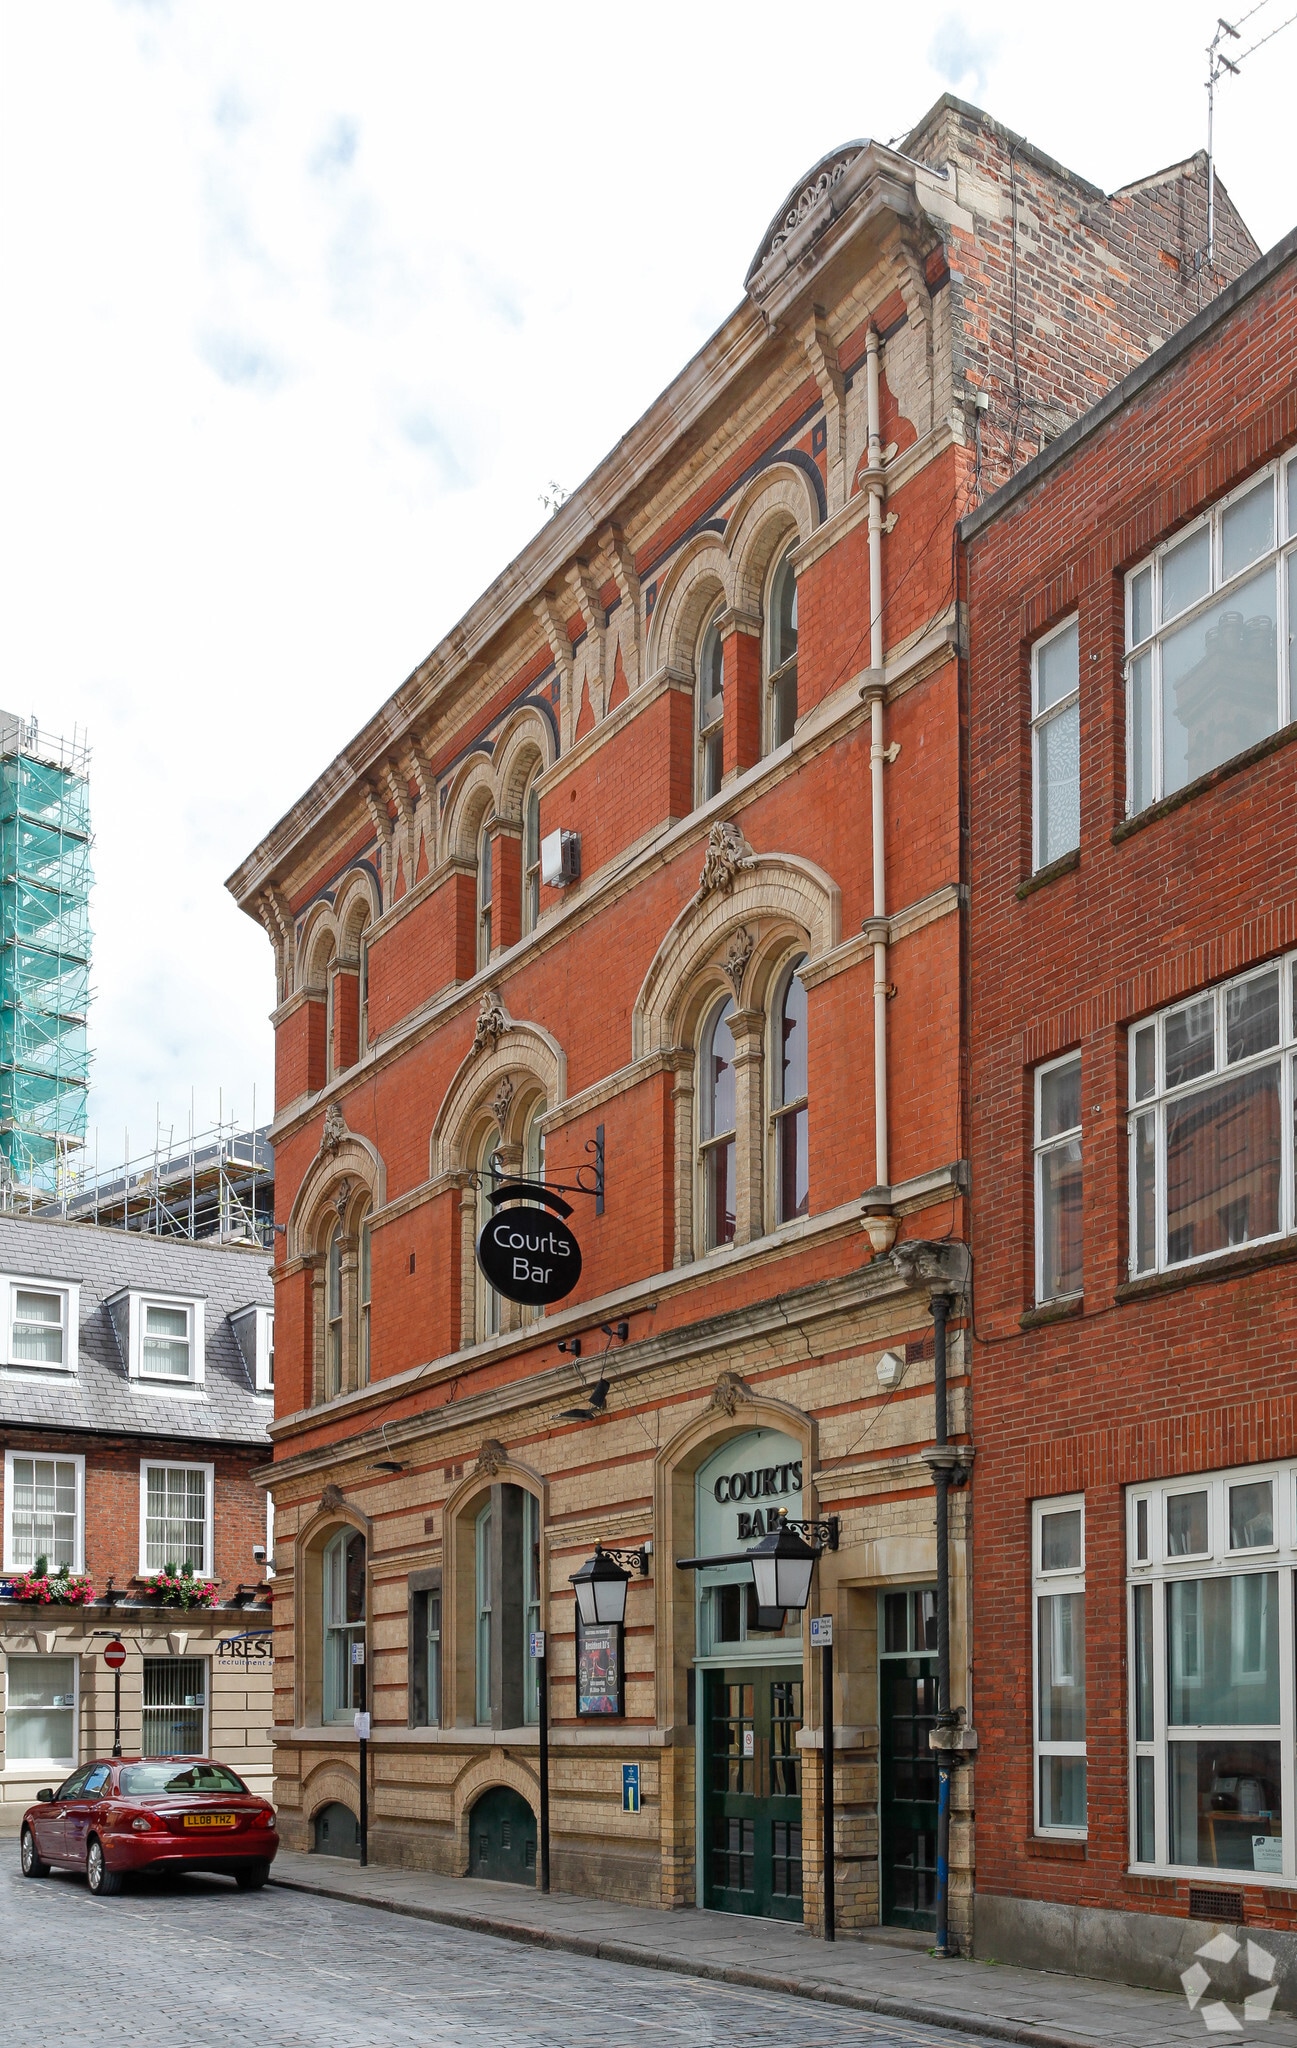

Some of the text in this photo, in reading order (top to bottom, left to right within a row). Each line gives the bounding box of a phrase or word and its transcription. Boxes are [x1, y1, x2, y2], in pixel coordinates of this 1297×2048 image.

[493, 1225, 571, 1257] Courts
[512, 1257, 553, 1284] Bar
[714, 1461, 803, 1503] COURTS
[737, 1507, 780, 1540] BAR
[187, 1815, 212, 1825] LL08
[214, 1815, 231, 1824] THZ
